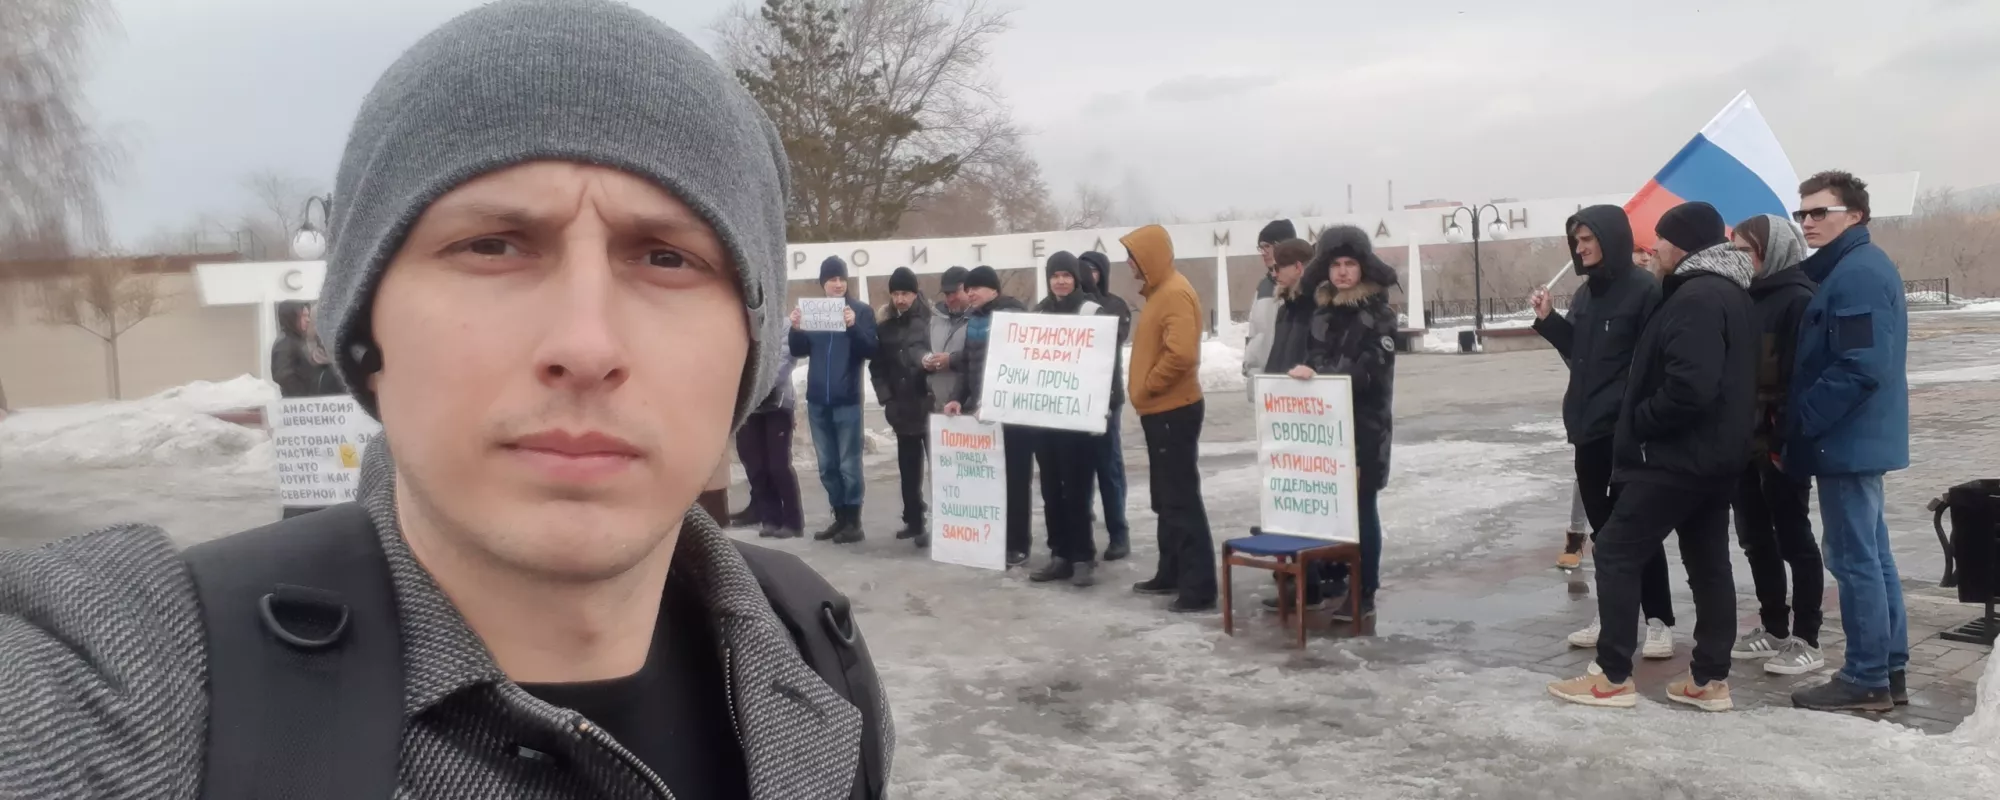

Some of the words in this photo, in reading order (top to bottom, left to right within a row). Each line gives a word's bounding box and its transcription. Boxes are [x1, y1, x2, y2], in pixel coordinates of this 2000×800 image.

[1007, 322, 1095, 348] ПУТИНСКИЕ
[997, 363, 1031, 387] РУКИ
[1036, 369, 1080, 391] ПРОЧЬ
[993, 389, 1008, 408] ОТ
[283, 403, 354, 415] АНАСТАСИЯ
[283, 414, 346, 426] ШЕВЧЕНКО
[276, 433, 348, 447] АРЕСТОВАНА
[275, 447, 321, 459] УЧАСТИЕ
[326, 447, 335, 457] В
[939, 455, 953, 467] ВЫ
[956, 451, 988, 464] ПРАВДА
[278, 463, 294, 473] ВЫ
[297, 462, 318, 472] ЧТО
[956, 464, 996, 480] ДУМАЕТЕ
[280, 475, 320, 485] ХОТИТЕ
[327, 472, 351, 483] КАК
[942, 485, 960, 499] ЧТО
[1270, 477, 1338, 496] ОТДЕЛЬНУЮ
[281, 488, 337, 500] СЕВЕРНОЙ
